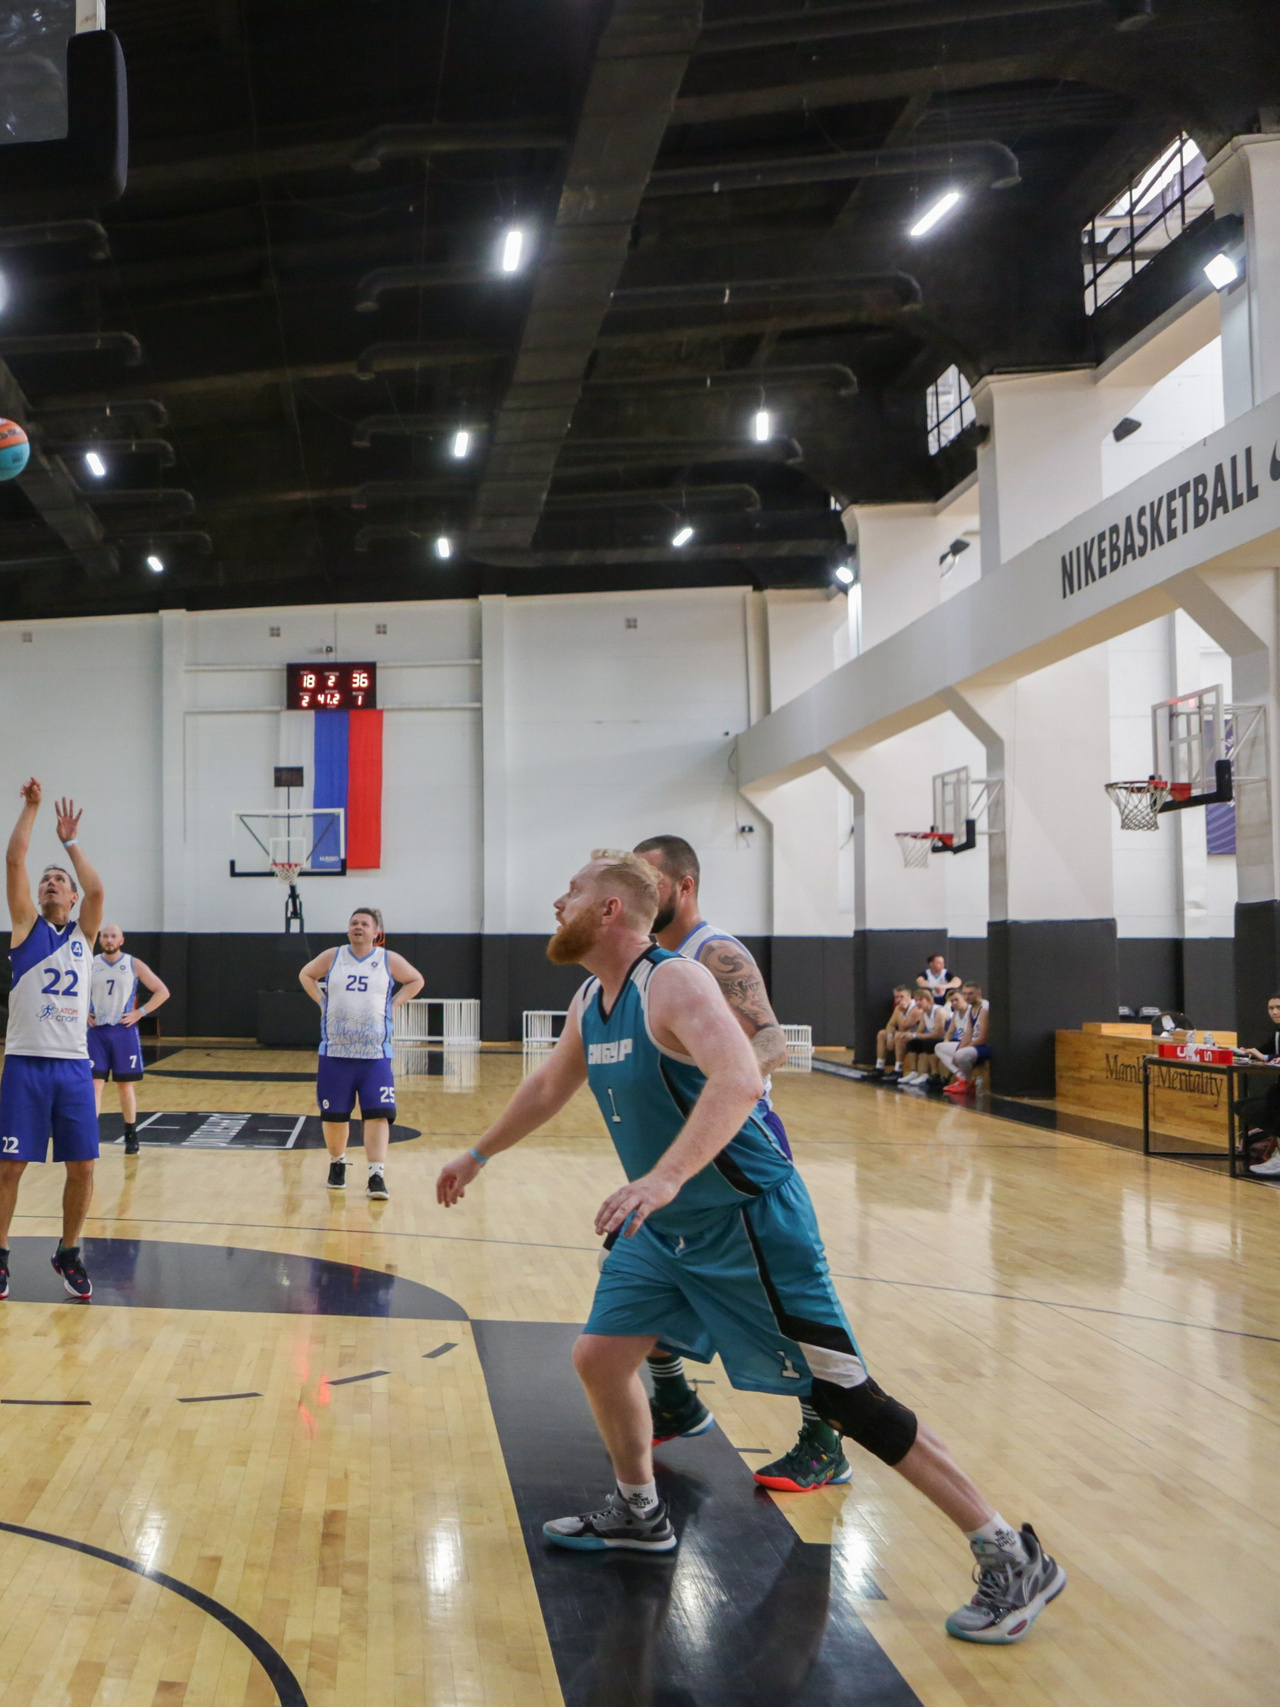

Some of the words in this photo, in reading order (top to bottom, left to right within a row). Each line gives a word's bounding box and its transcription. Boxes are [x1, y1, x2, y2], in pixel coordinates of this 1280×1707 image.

[1061, 446, 1259, 600] NIKEBASKETBALL
[303, 674, 316, 688] 18
[327, 675, 336, 687] 2
[352, 673, 368, 688] 36
[301, 695, 310, 707] 2
[41, 967, 79, 997] 22
[106, 979, 116, 995] 7
[345, 974, 369, 992] 25
[129, 1054, 138, 1069] 7
[607, 1088, 622, 1123] 1
[776, 1350, 801, 1379] 1
